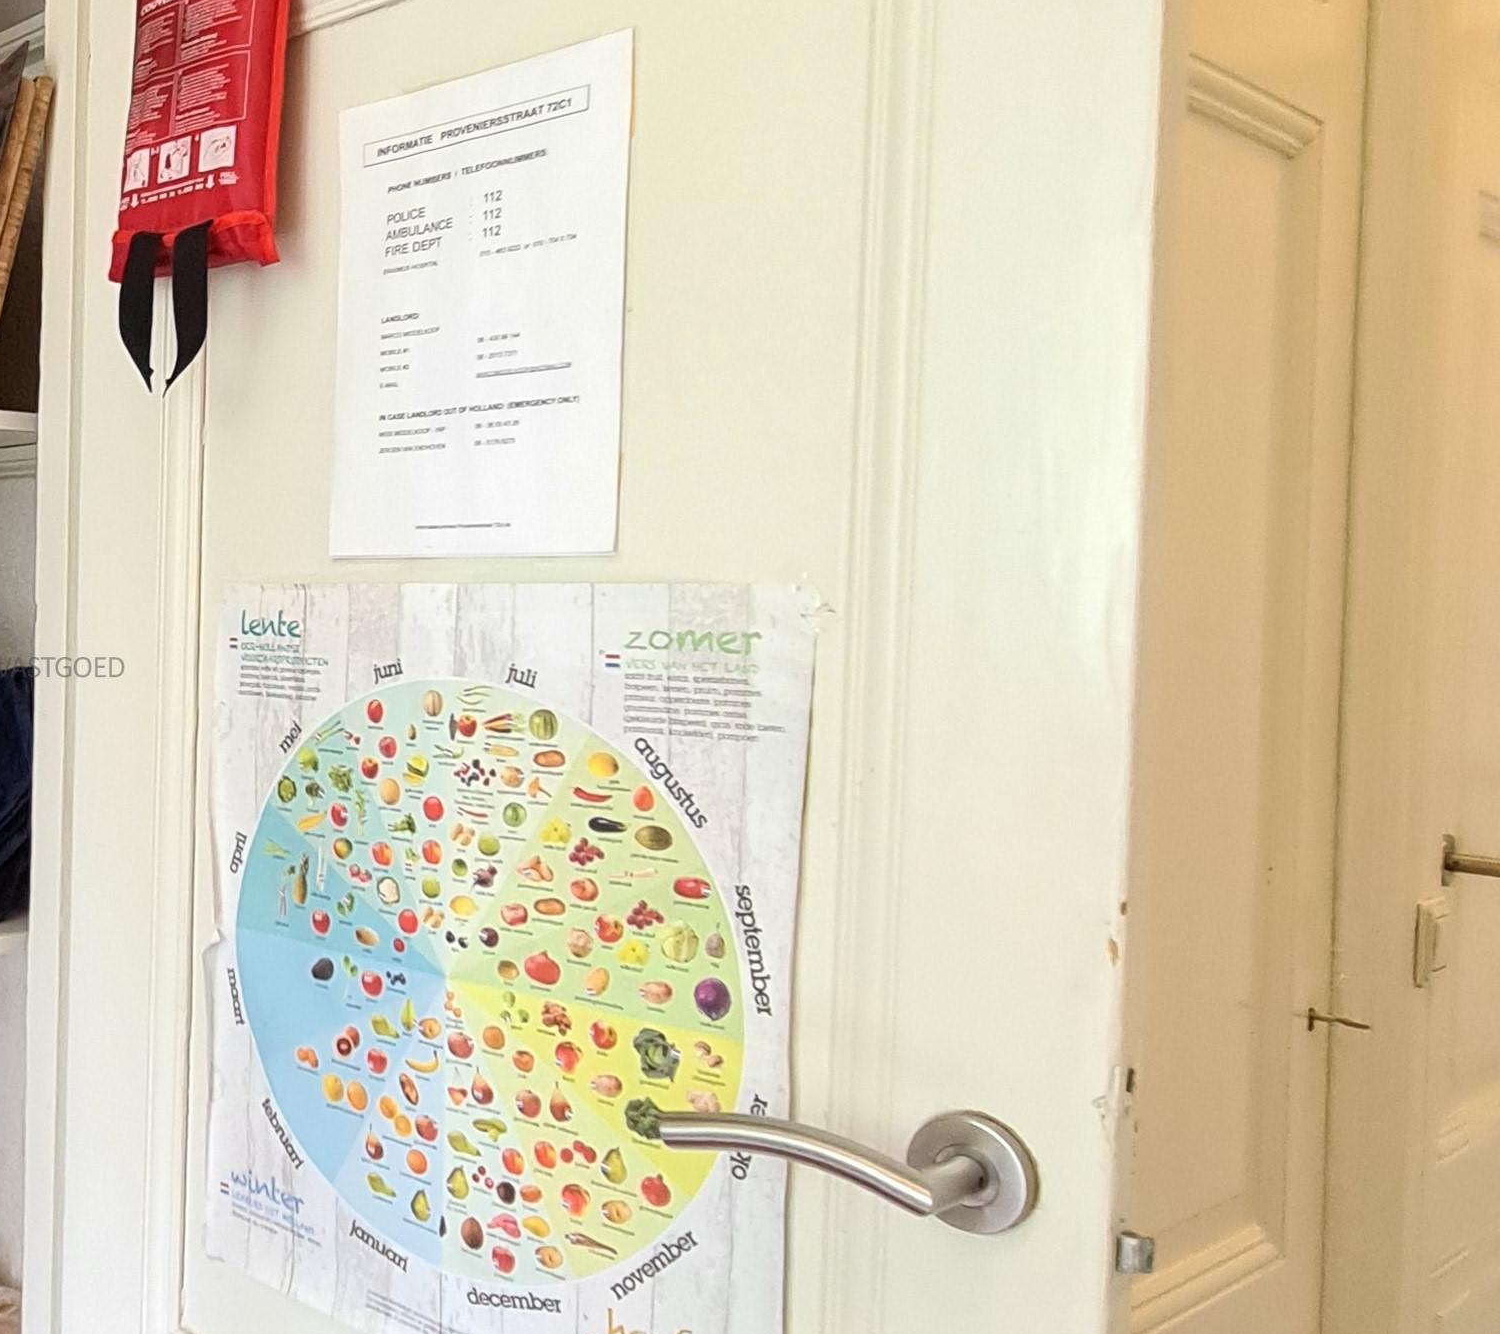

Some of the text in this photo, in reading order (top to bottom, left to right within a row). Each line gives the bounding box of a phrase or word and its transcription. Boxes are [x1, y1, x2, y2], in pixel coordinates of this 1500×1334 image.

[376, 134, 433, 158] INFORMATIE
[439, 103, 544, 141] PROVENIERSSTRAAT
[385, 217, 454, 242] AMBULANCE
[481, 207, 503, 221] 112
[386, 206, 427, 225] POLICE
[482, 190, 504, 204] 112
[384, 243, 409, 258] FIRE
[411, 236, 443, 253] DEPT
[481, 224, 502, 239] 112
[241, 609, 302, 639] lente
[624, 629, 763, 656] zomer
[373, 658, 404, 684] juni
[505, 662, 538, 689] juli
[279, 720, 303, 754] mei
[633, 736, 709, 831] augustus
[229, 831, 248, 875] april
[734, 884, 773, 1018] september
[227, 967, 246, 1026] maart
[261, 1098, 305, 1170] februari
[231, 1168, 305, 1215] winter
[349, 1219, 409, 1274] januari
[609, 1230, 699, 1301] november
[466, 1287, 562, 1314] december
